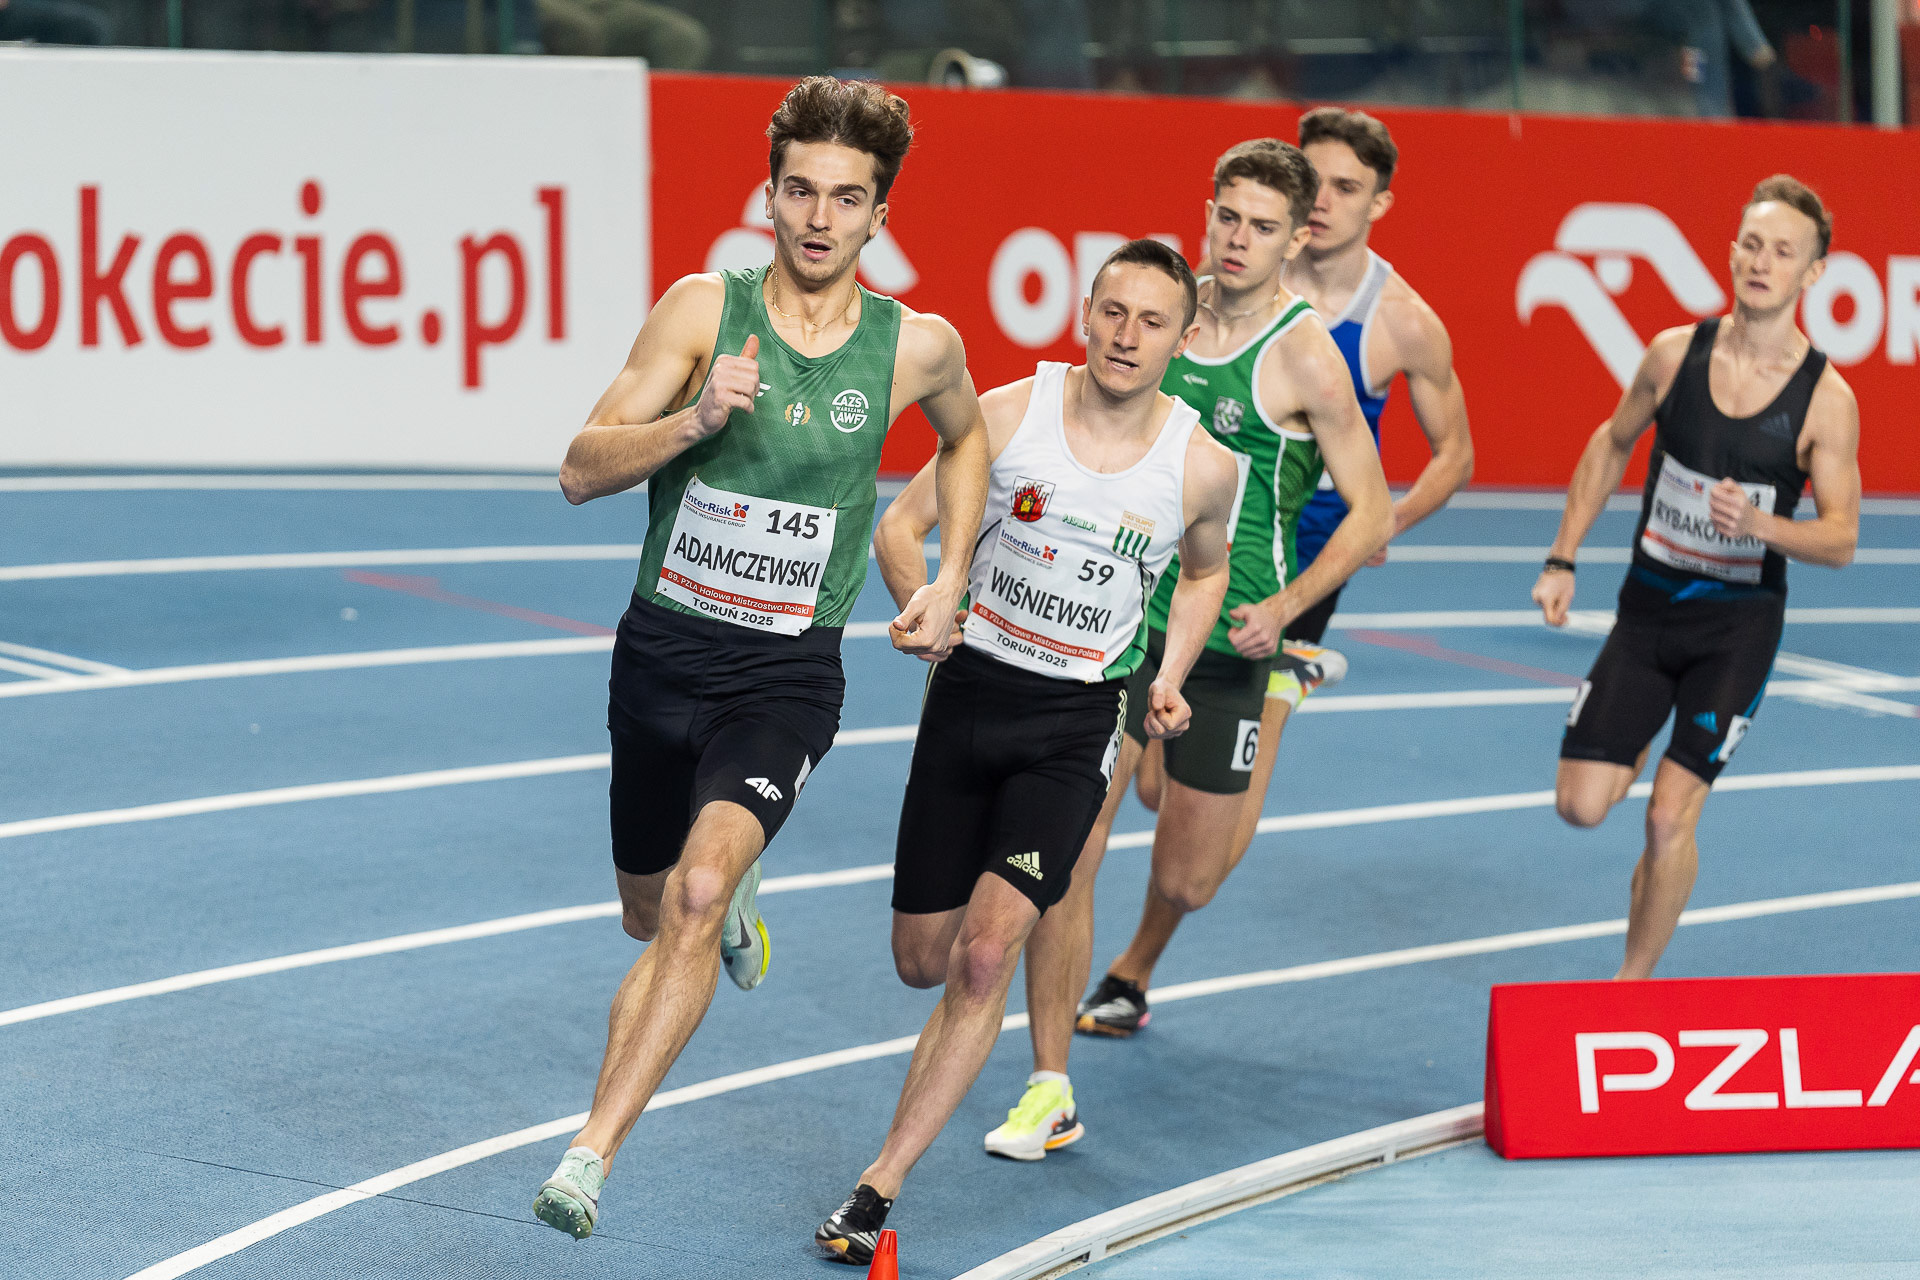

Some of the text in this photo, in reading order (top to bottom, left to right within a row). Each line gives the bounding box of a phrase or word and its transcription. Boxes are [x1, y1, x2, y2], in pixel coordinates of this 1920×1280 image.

[835, 406, 865, 414] WARSZAWA
[840, 396, 862, 408] AZS
[836, 412, 864, 425] AWF
[685, 490, 732, 516] InterRisk
[699, 512, 727, 525] INSURANCE
[766, 509, 820, 540] 145
[1001, 529, 1041, 557] InterRisk
[673, 532, 821, 588] ADAMCZEWSKI
[1077, 559, 1115, 586] 59
[667, 571, 810, 615] 69. PZLA Halowe Mistrzostwa Polski
[990, 566, 1112, 634] WIŚNIEWSKI
[692, 597, 774, 626] TORUŃ 2025
[989, 612, 1004, 627] PZLA
[1004, 622, 1031, 640] Halowe
[1031, 634, 1078, 655] Mistrzostwa
[1077, 648, 1100, 660] Polski
[997, 632, 1068, 668] TORUŃ 2025
[1242, 727, 1259, 766] 6
[1006, 856, 1044, 880] adidas
